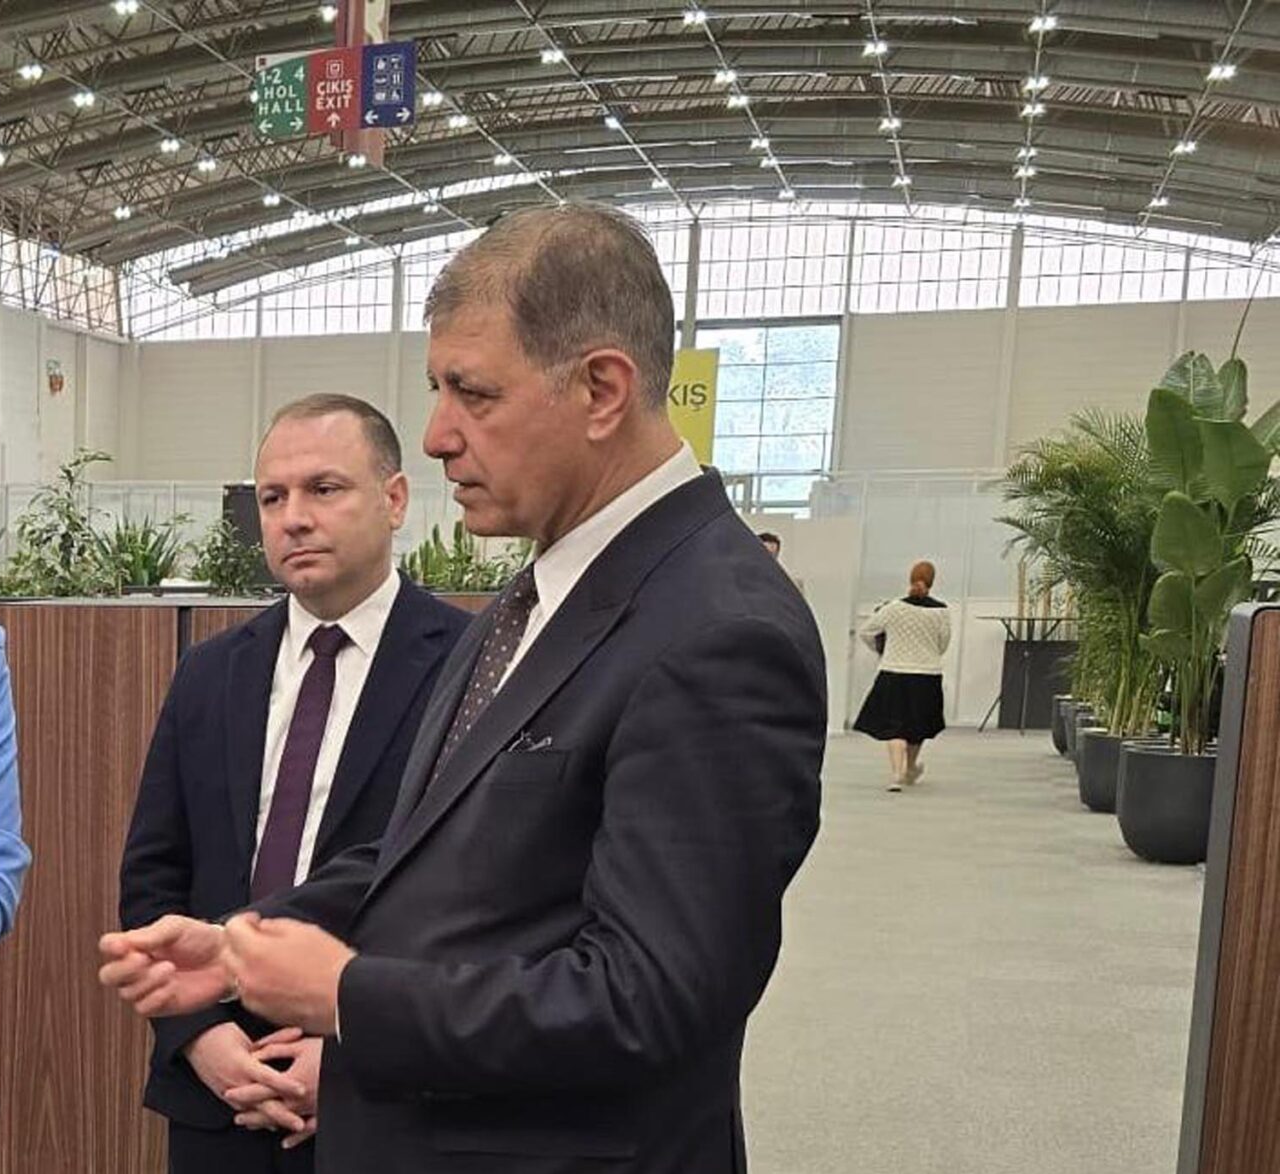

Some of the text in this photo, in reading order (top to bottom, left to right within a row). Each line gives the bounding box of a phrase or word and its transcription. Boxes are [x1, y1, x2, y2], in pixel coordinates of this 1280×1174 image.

[259, 65, 305, 85] 1-2 4
[264, 85, 297, 99] HOL
[258, 99, 304, 115] HALL
[315, 95, 352, 111] EXIT
[668, 383, 707, 412] KIŞ
